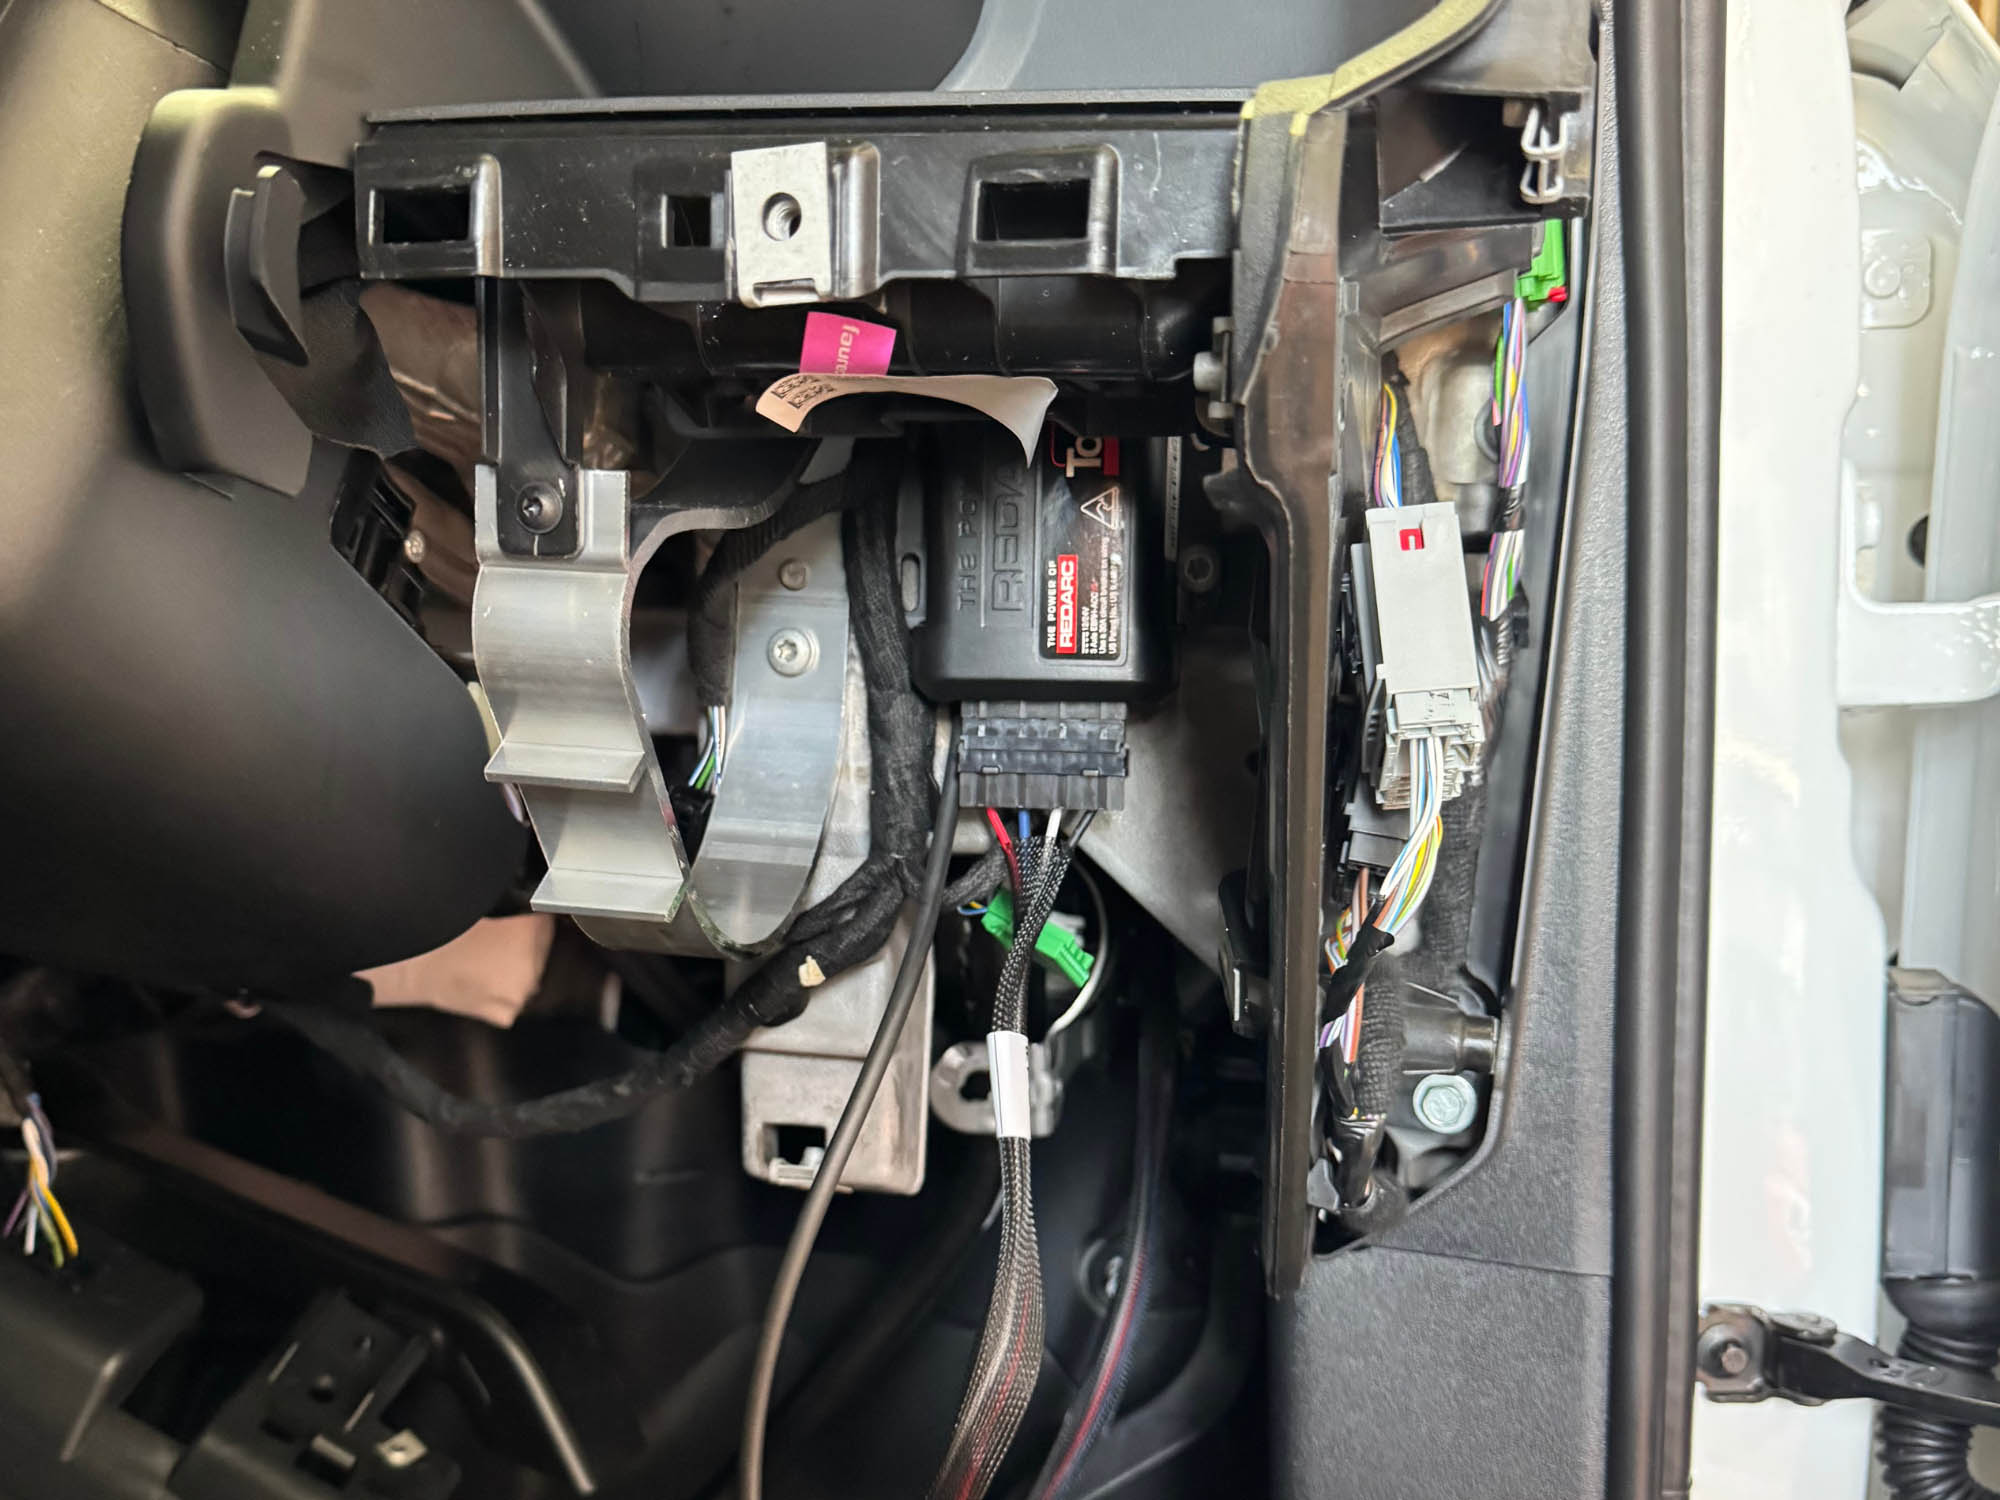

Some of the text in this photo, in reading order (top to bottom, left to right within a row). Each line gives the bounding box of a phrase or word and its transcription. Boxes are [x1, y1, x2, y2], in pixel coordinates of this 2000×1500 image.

[957, 552, 978, 612] THE
[1047, 560, 1057, 648] THE POWER OF
[1059, 560, 1075, 648] REDARC
